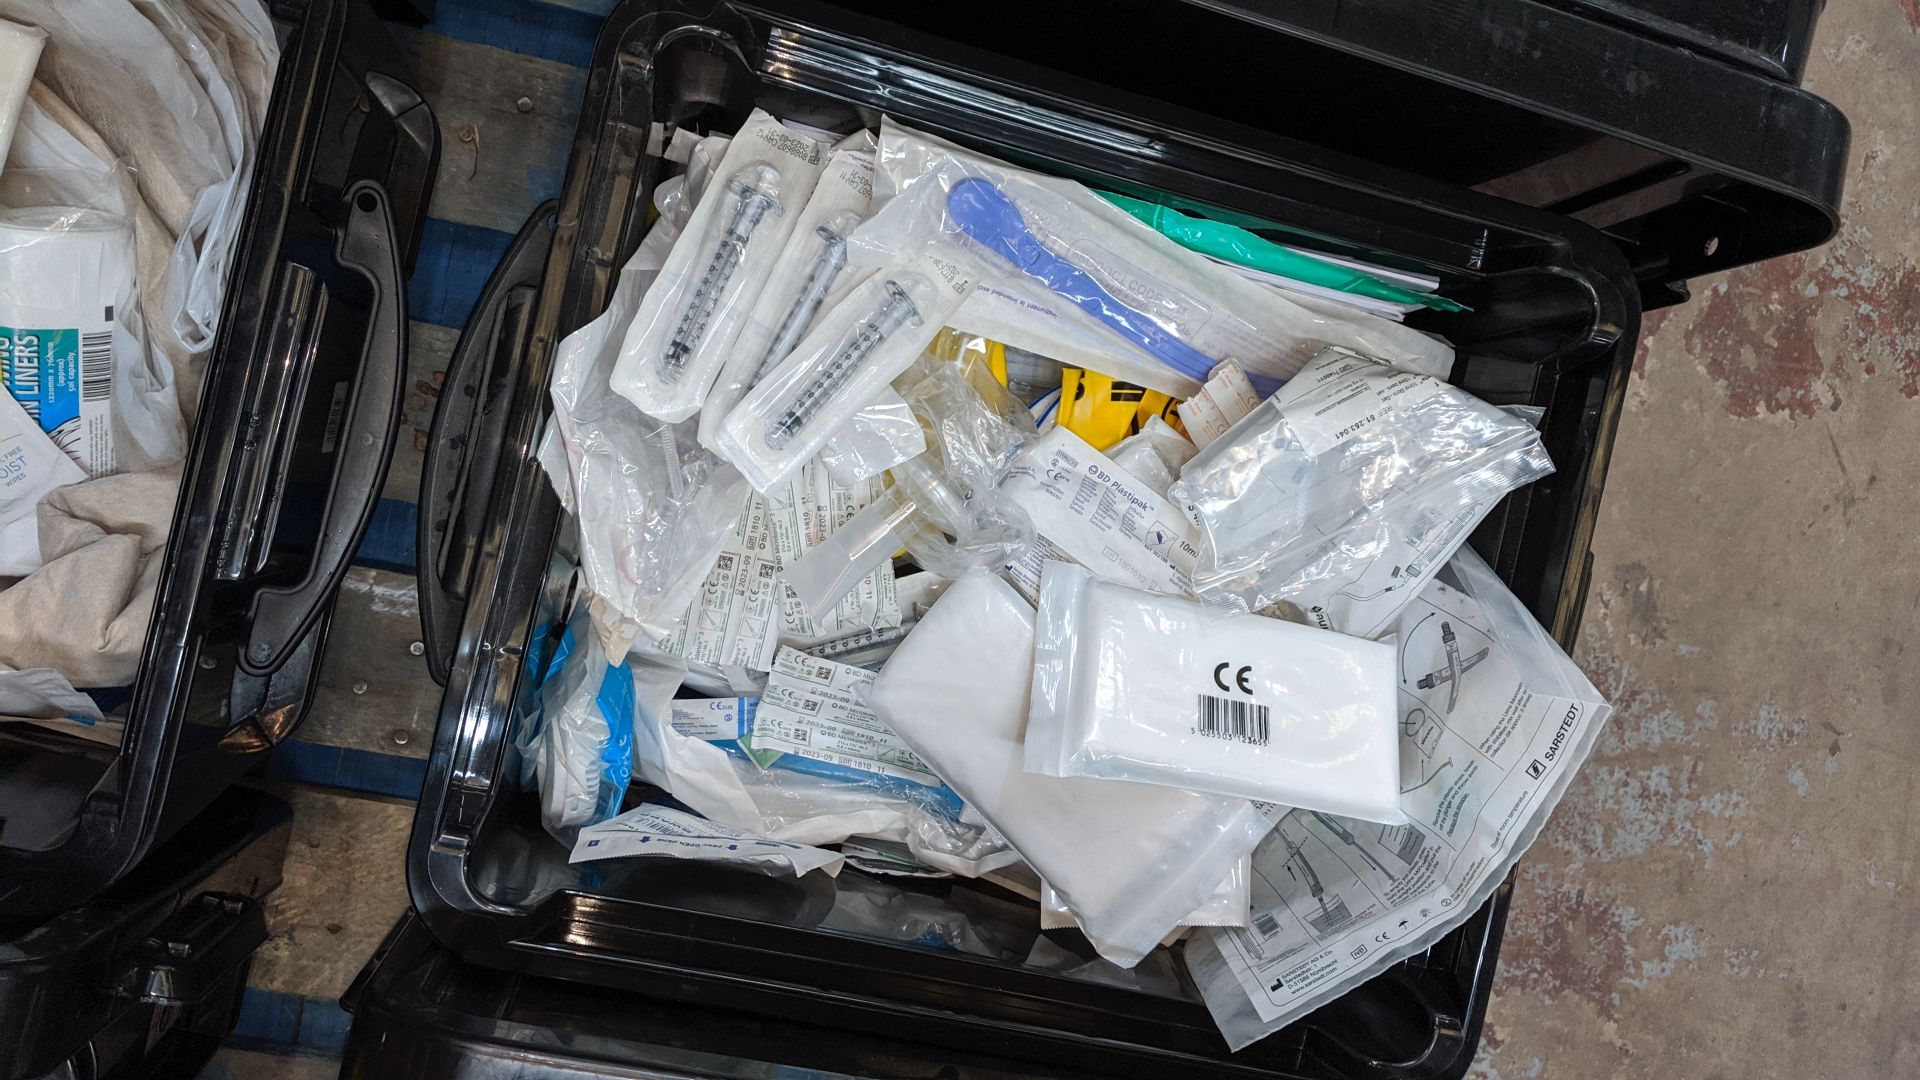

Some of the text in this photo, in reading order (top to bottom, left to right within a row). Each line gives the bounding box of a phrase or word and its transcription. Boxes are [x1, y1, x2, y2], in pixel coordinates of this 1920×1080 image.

[990, 287, 1019, 304] intended
[14, 333, 38, 394] LINERS
[55, 357, 65, 386] (approx)
[66, 351, 76, 379] capacity
[46, 375, 55, 403] 1220mm
[1376, 404, 1393, 417] REF
[3, 444, 23, 460] FREE
[3, 471, 26, 488] WIPES
[1096, 470, 1112, 484] BD
[754, 501, 762, 510] 11
[750, 514, 760, 534] 1810
[818, 513, 826, 541] 2023-0
[760, 531, 768, 542] BD
[1177, 539, 1200, 560] 10m
[776, 555, 782, 565] BD
[738, 554, 751, 588] 2023-09
[707, 580, 719, 595] CE
[748, 587, 759, 603] CE
[863, 575, 872, 599] 10 11
[793, 654, 808, 666] CE
[1213, 662, 1255, 695] CE
[709, 701, 722, 710] CE
[817, 690, 850, 703] 2023-09
[804, 719, 837, 732] 2023-09
[856, 731, 874, 741] 1810
[1199, 728, 1233, 741] 025503
[1478, 735, 1491, 750] When
[1488, 723, 1501, 738] using
[1543, 702, 1580, 762] SARSTEDT
[1484, 743, 1494, 754] with
[1489, 736, 1508, 758] collection
[800, 748, 833, 762] 2023-09
[852, 760, 872, 770] 1810
[875, 765, 885, 773] 11
[1431, 808, 1442, 826] Remove
[1437, 799, 1445, 808] the
[1442, 799, 1454, 817] plunger
[1450, 789, 1459, 800] and
[1498, 817, 1510, 832] room
[1506, 789, 1529, 819] temperature
[1409, 869, 1427, 888] position
[1352, 946, 1365, 957] IVD
[1280, 960, 1310, 979] SARSTEDT
[1290, 966, 1338, 995] www.sarstedt.com
